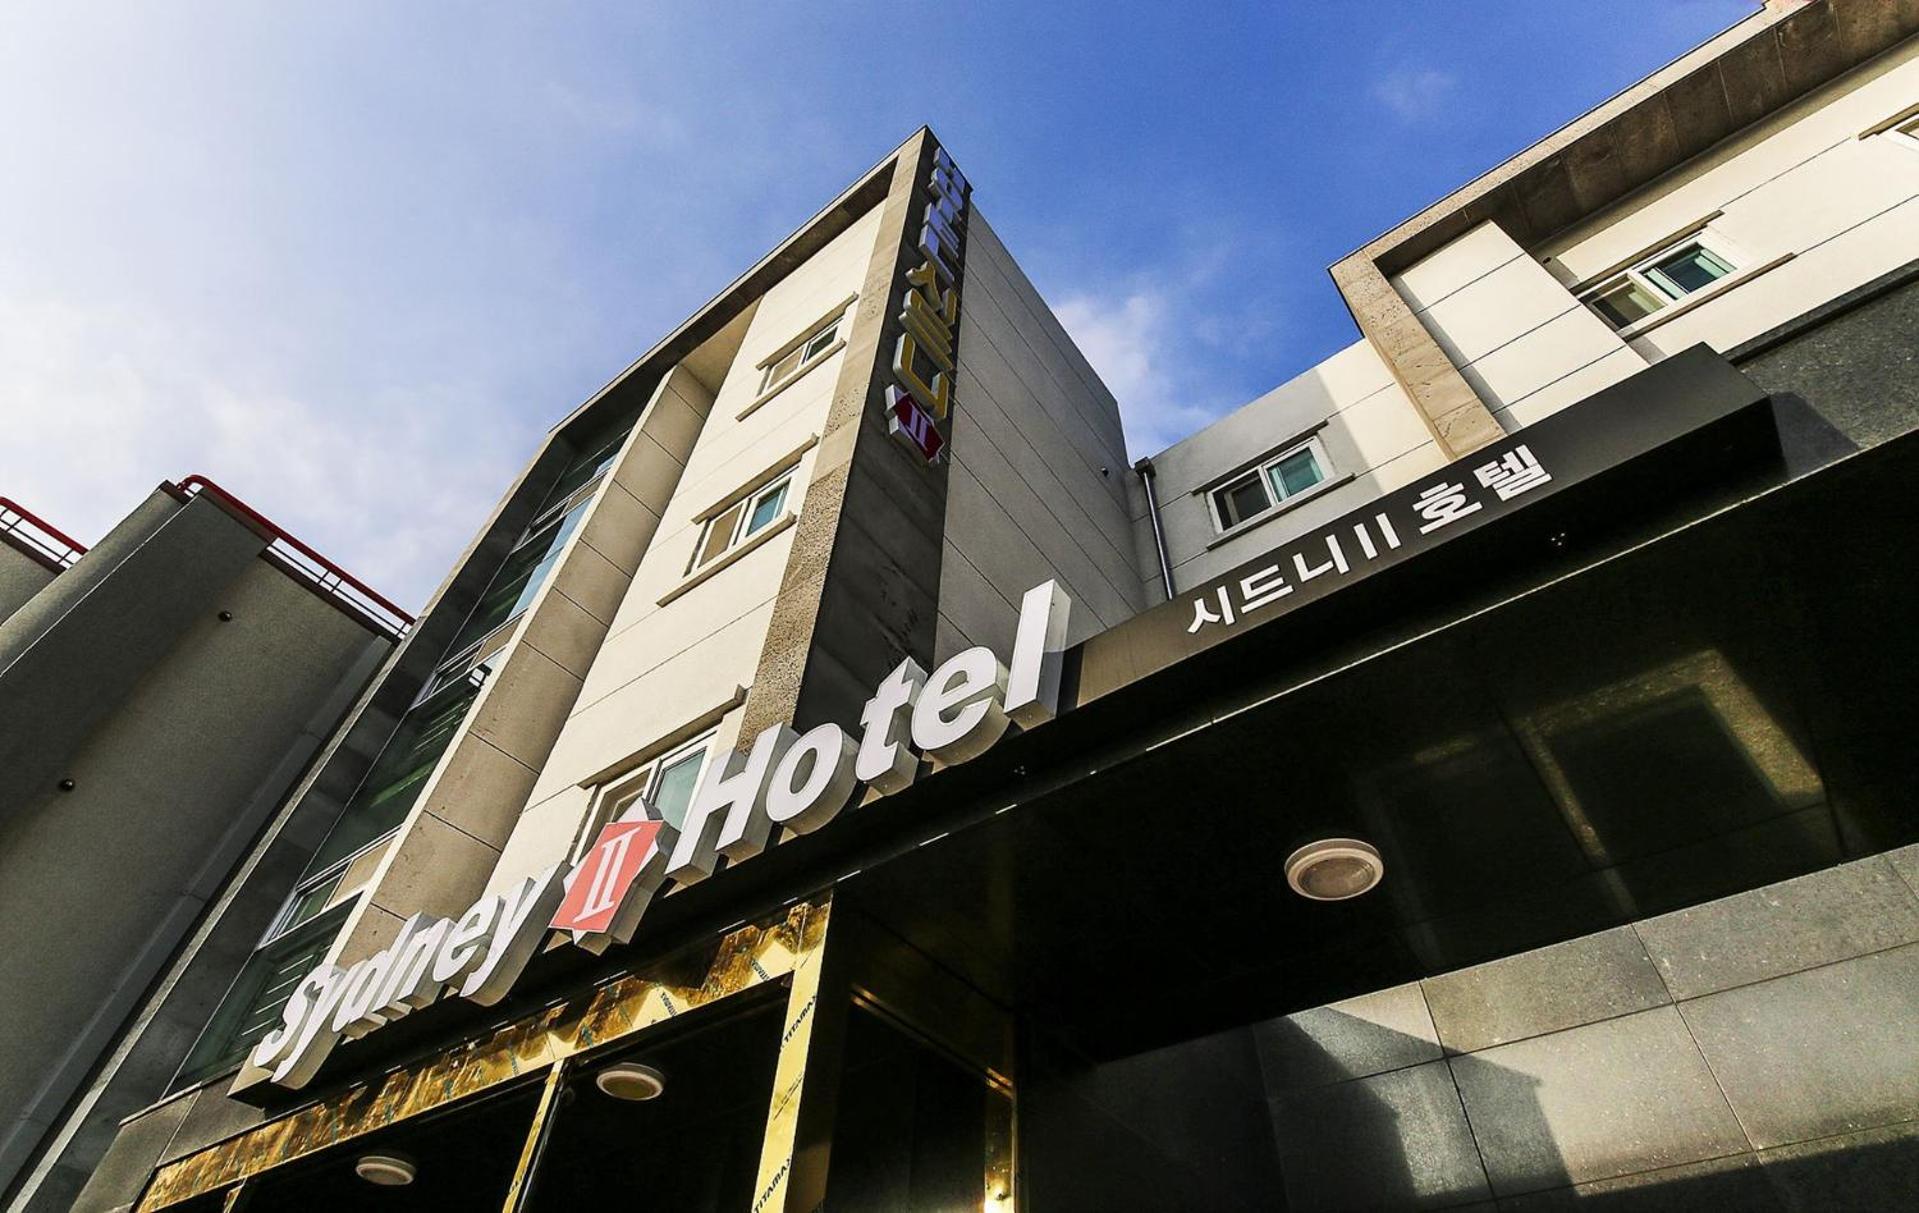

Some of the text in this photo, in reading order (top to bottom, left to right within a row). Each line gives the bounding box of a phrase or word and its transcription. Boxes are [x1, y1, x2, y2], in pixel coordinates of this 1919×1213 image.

[1413, 444, 1552, 536] 호텔
[254, 860, 565, 1083] Sydney
[664, 578, 1056, 876] Hotel
